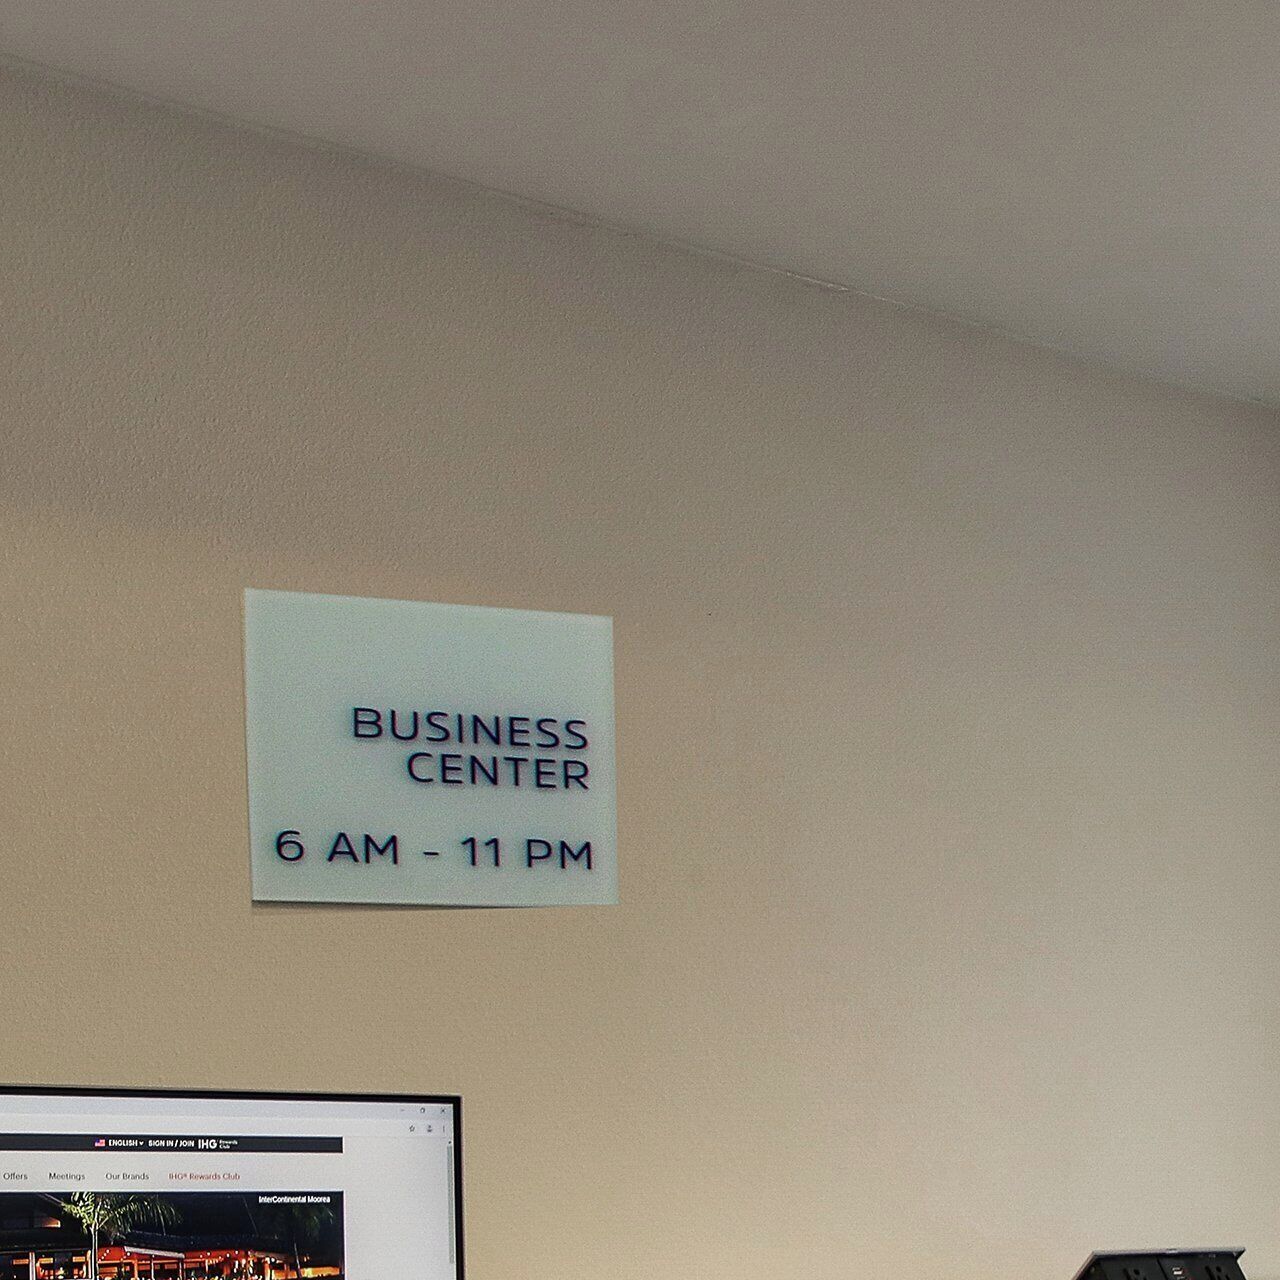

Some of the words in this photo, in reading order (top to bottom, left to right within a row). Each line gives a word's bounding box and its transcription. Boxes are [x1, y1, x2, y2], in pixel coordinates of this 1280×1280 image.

[353, 707, 588, 750] BUSINESS
[407, 752, 590, 790] CENTER
[275, 830, 305, 862] 6
[328, 832, 398, 865] AM
[461, 837, 501, 868] 11
[527, 838, 593, 870] PM
[108, 1139, 138, 1147] ENGLISH
[148, 1139, 165, 1147] SIGN
[166, 1139, 174, 1147] IN
[179, 1139, 195, 1147] JOIN
[198, 1138, 217, 1149] IHG
[3, 1172, 28, 1180] Offers
[49, 1172, 86, 1181] Meetings
[105, 1172, 120, 1180] Our
[122, 1172, 149, 1180] Brands
[189, 1172, 220, 1181] Rewards
[222, 1172, 240, 1180] Club
[259, 1195, 307, 1203] InterContinental
